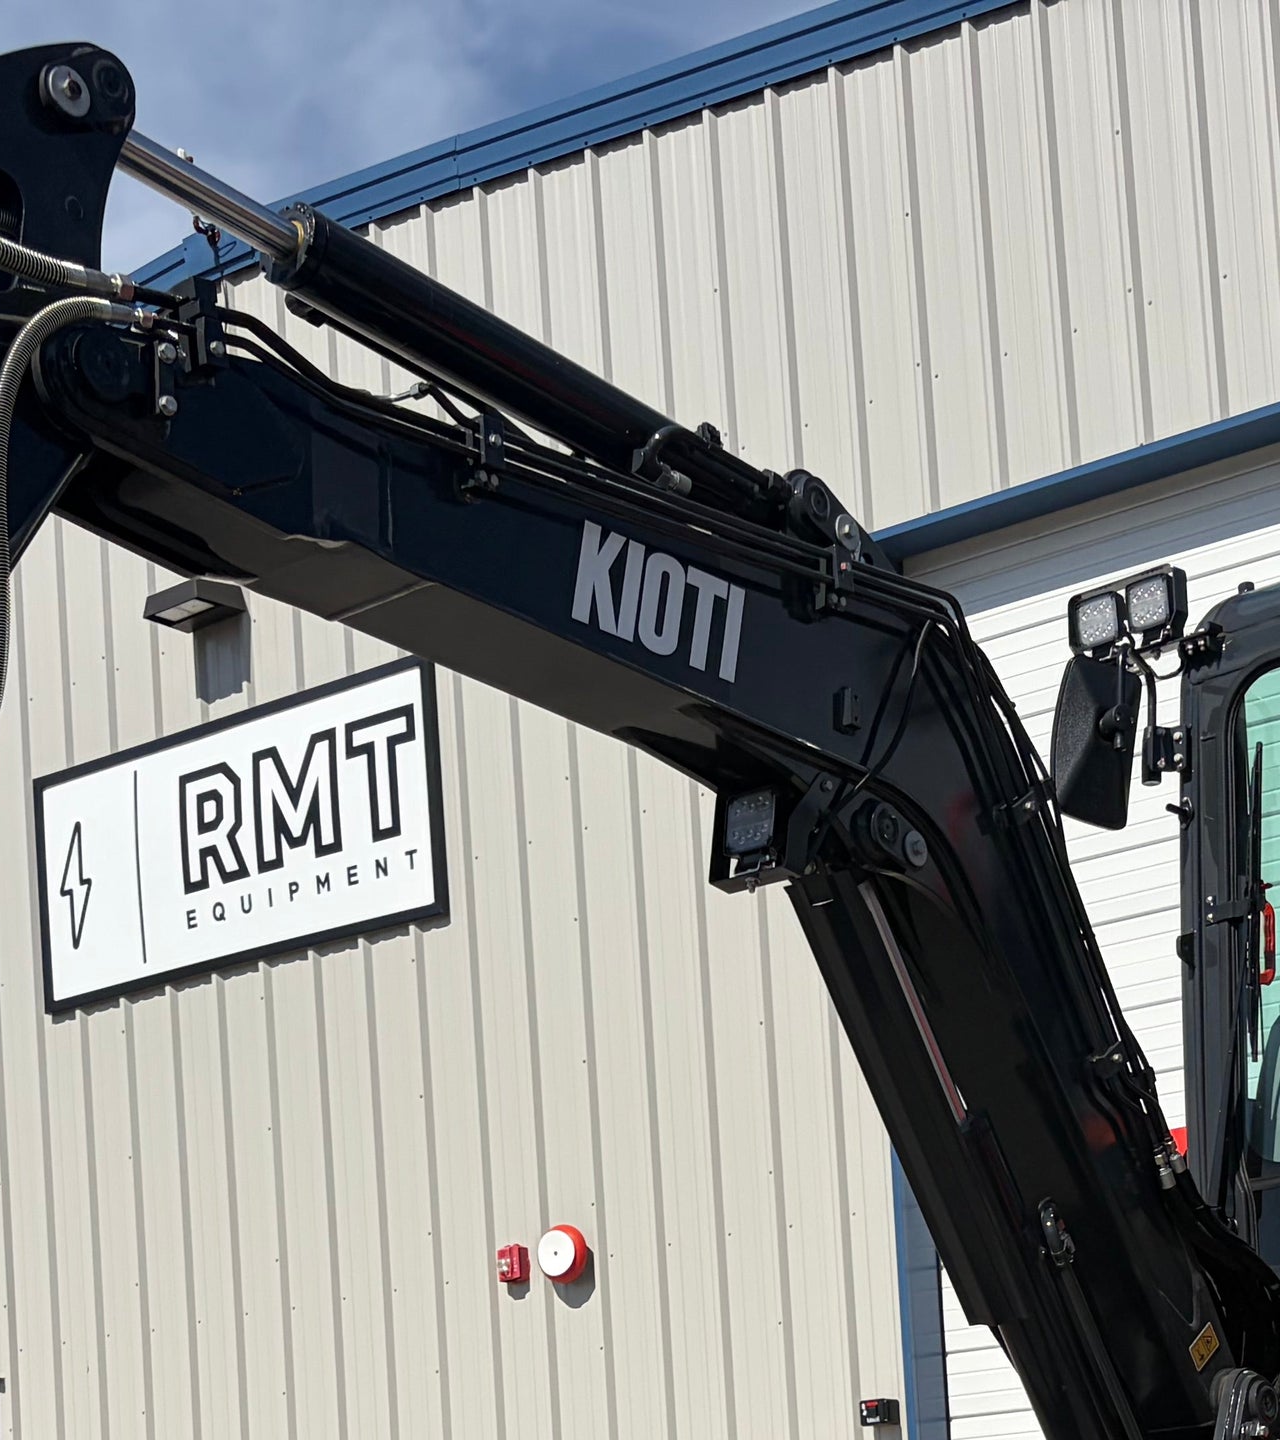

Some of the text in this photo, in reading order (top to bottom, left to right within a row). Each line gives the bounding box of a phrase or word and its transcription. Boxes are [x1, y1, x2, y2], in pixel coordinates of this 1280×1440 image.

[571, 519, 746, 684] KIOTI
[178, 703, 416, 895] RMT
[185, 849, 419, 930] EQUIPMENT
